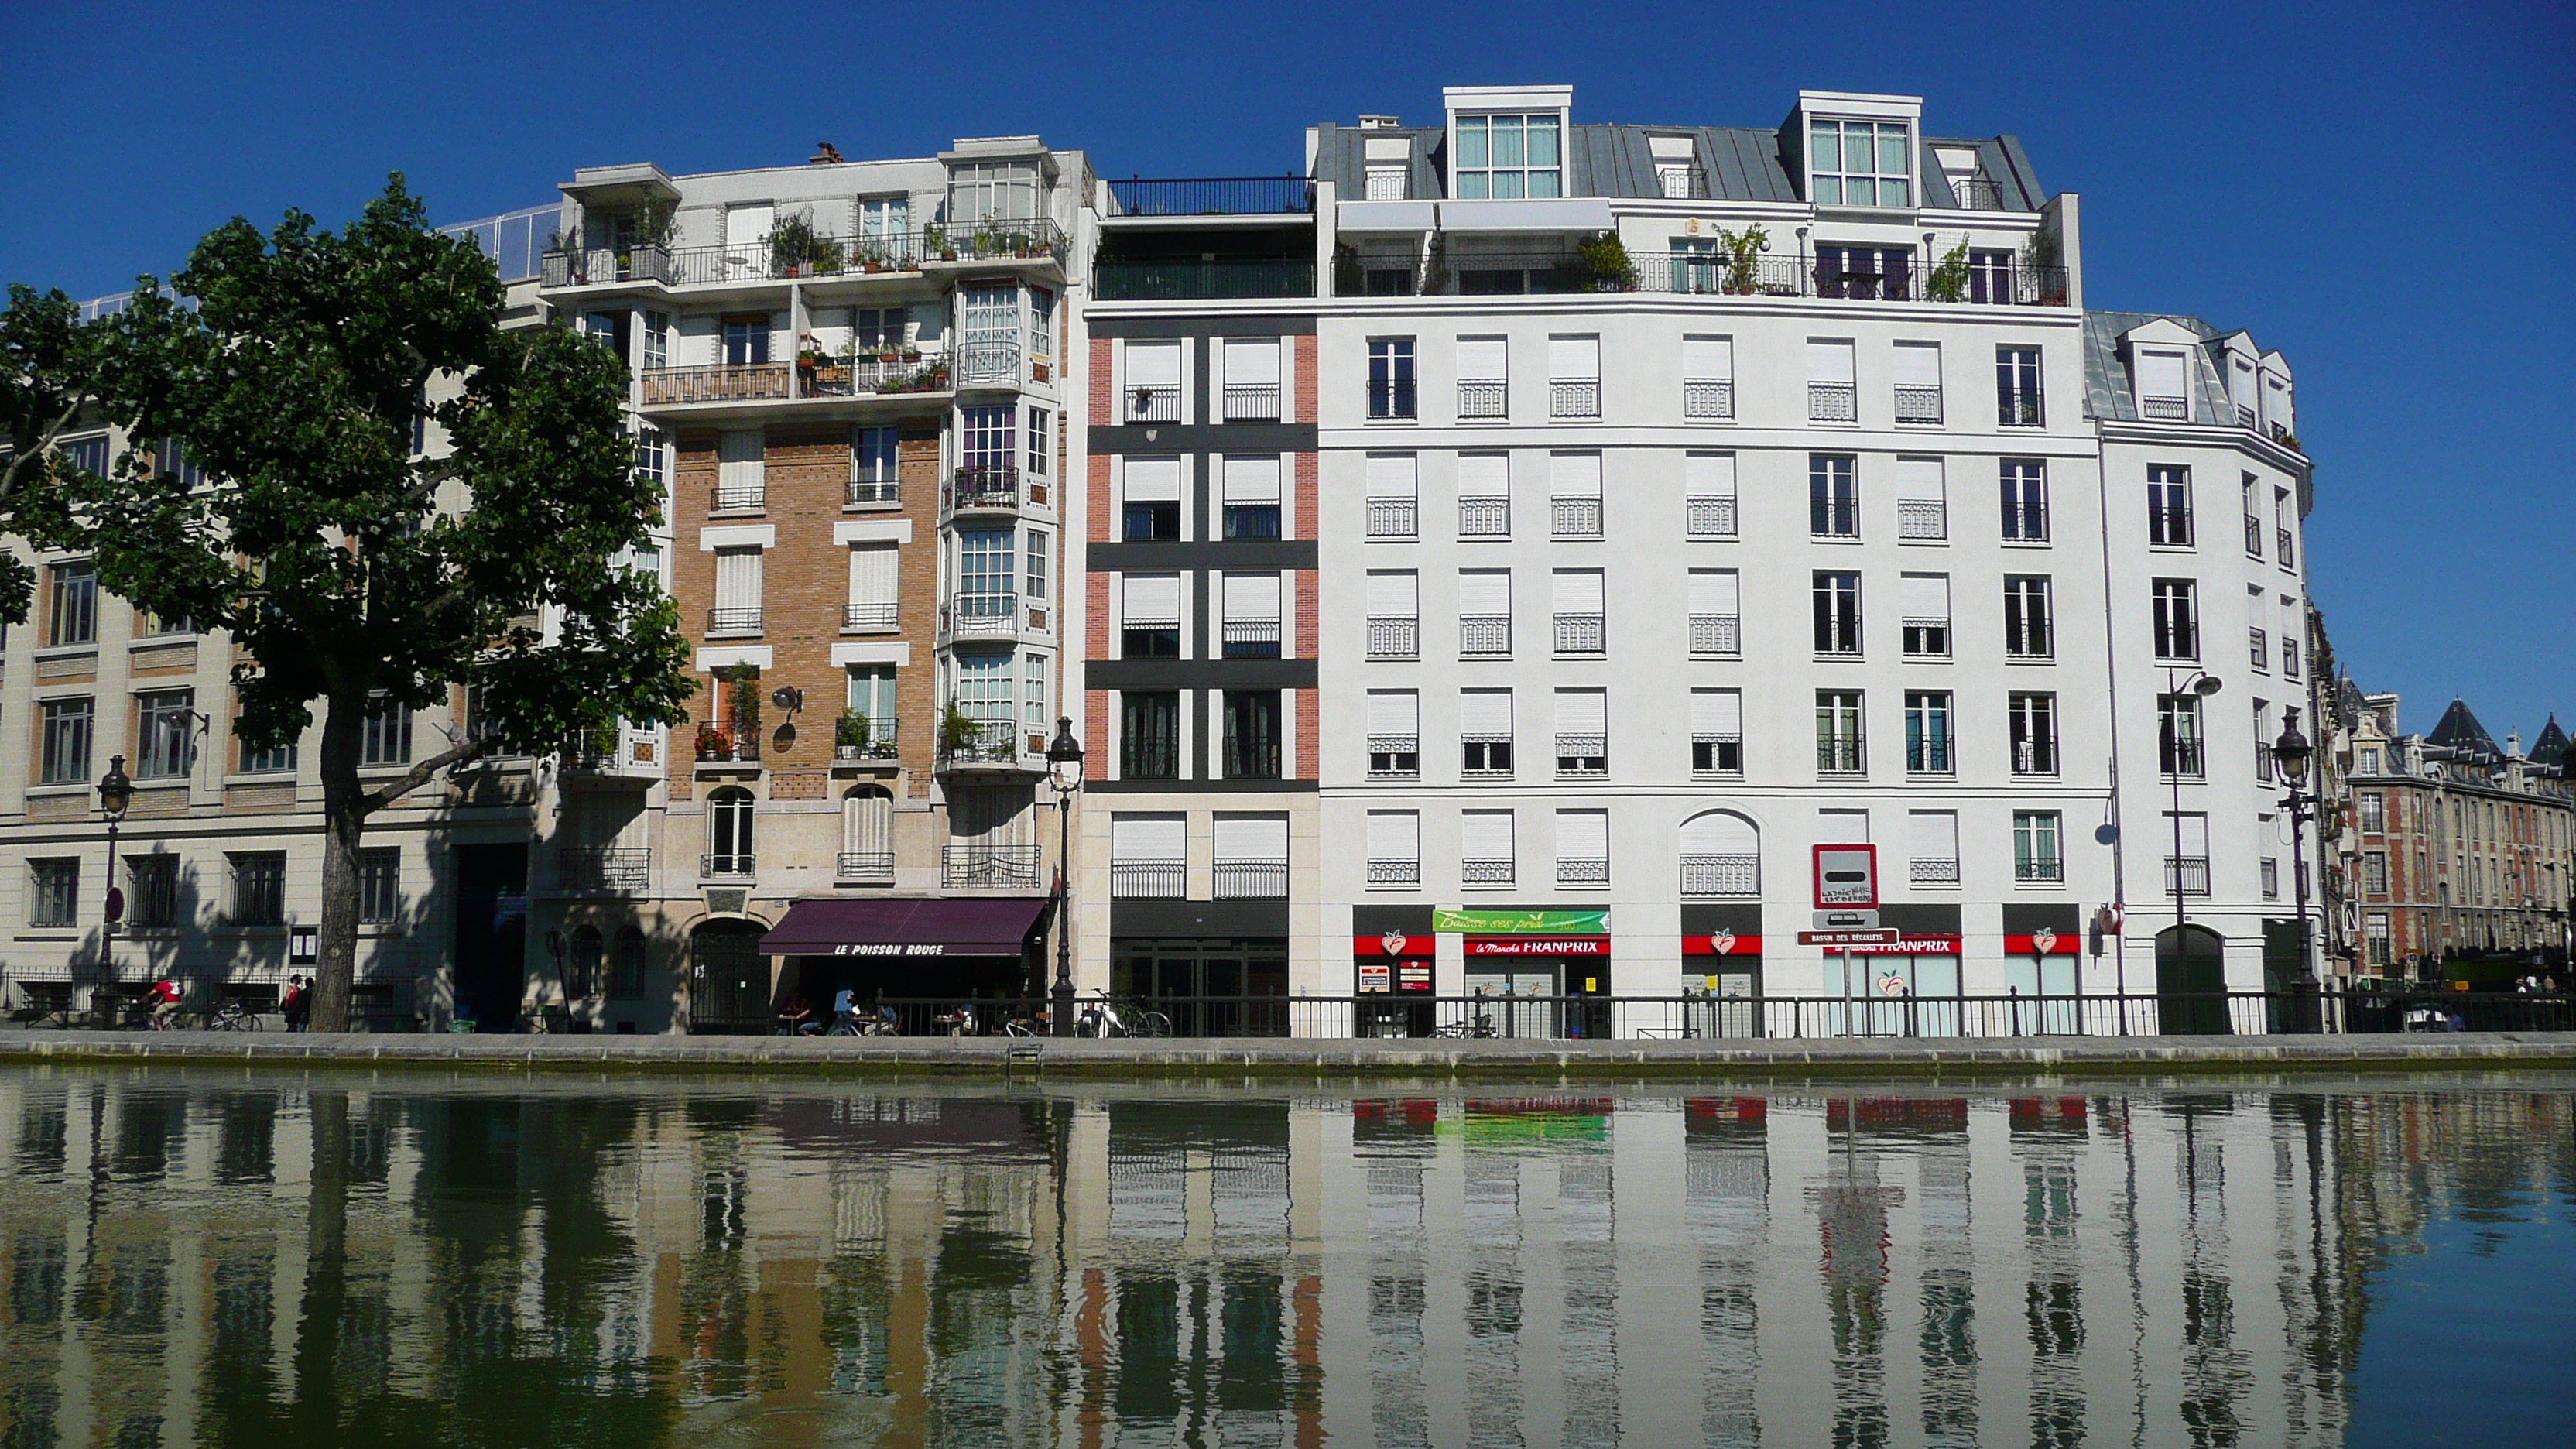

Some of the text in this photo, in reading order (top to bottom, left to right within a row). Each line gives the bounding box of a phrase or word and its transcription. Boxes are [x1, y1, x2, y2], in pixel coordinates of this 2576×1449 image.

[1440, 913, 1544, 933] Baisse ses prix
[834, 944, 944, 955] LE POISSON ROUGE
[1523, 941, 1598, 953] FRANPRIX
